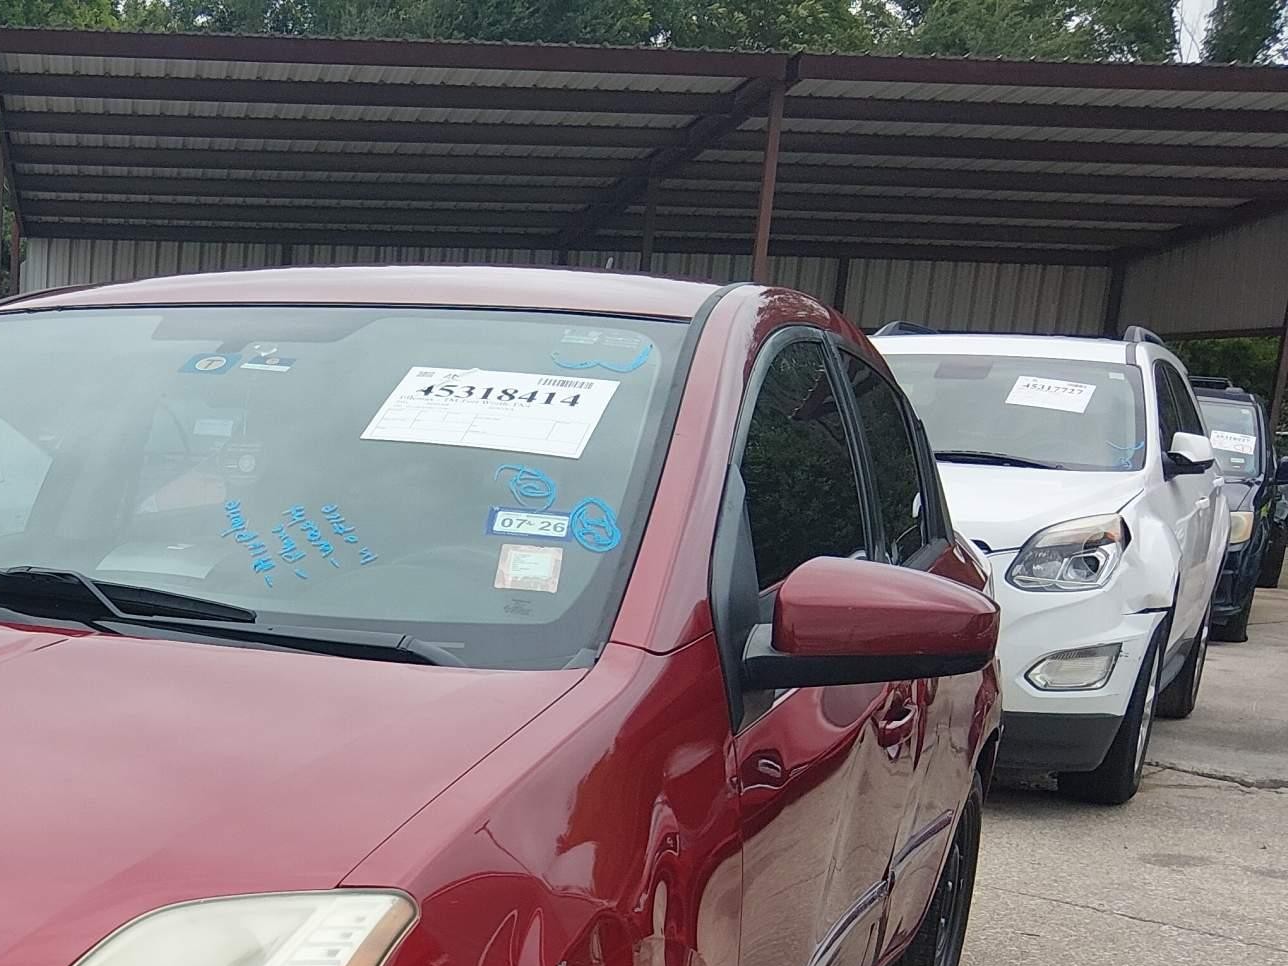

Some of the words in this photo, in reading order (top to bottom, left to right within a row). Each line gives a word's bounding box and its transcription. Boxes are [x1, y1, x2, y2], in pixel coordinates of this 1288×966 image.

[415, 384, 582, 407] 45318414
[500, 516, 527, 530] 07
[538, 520, 566, 534] 26
